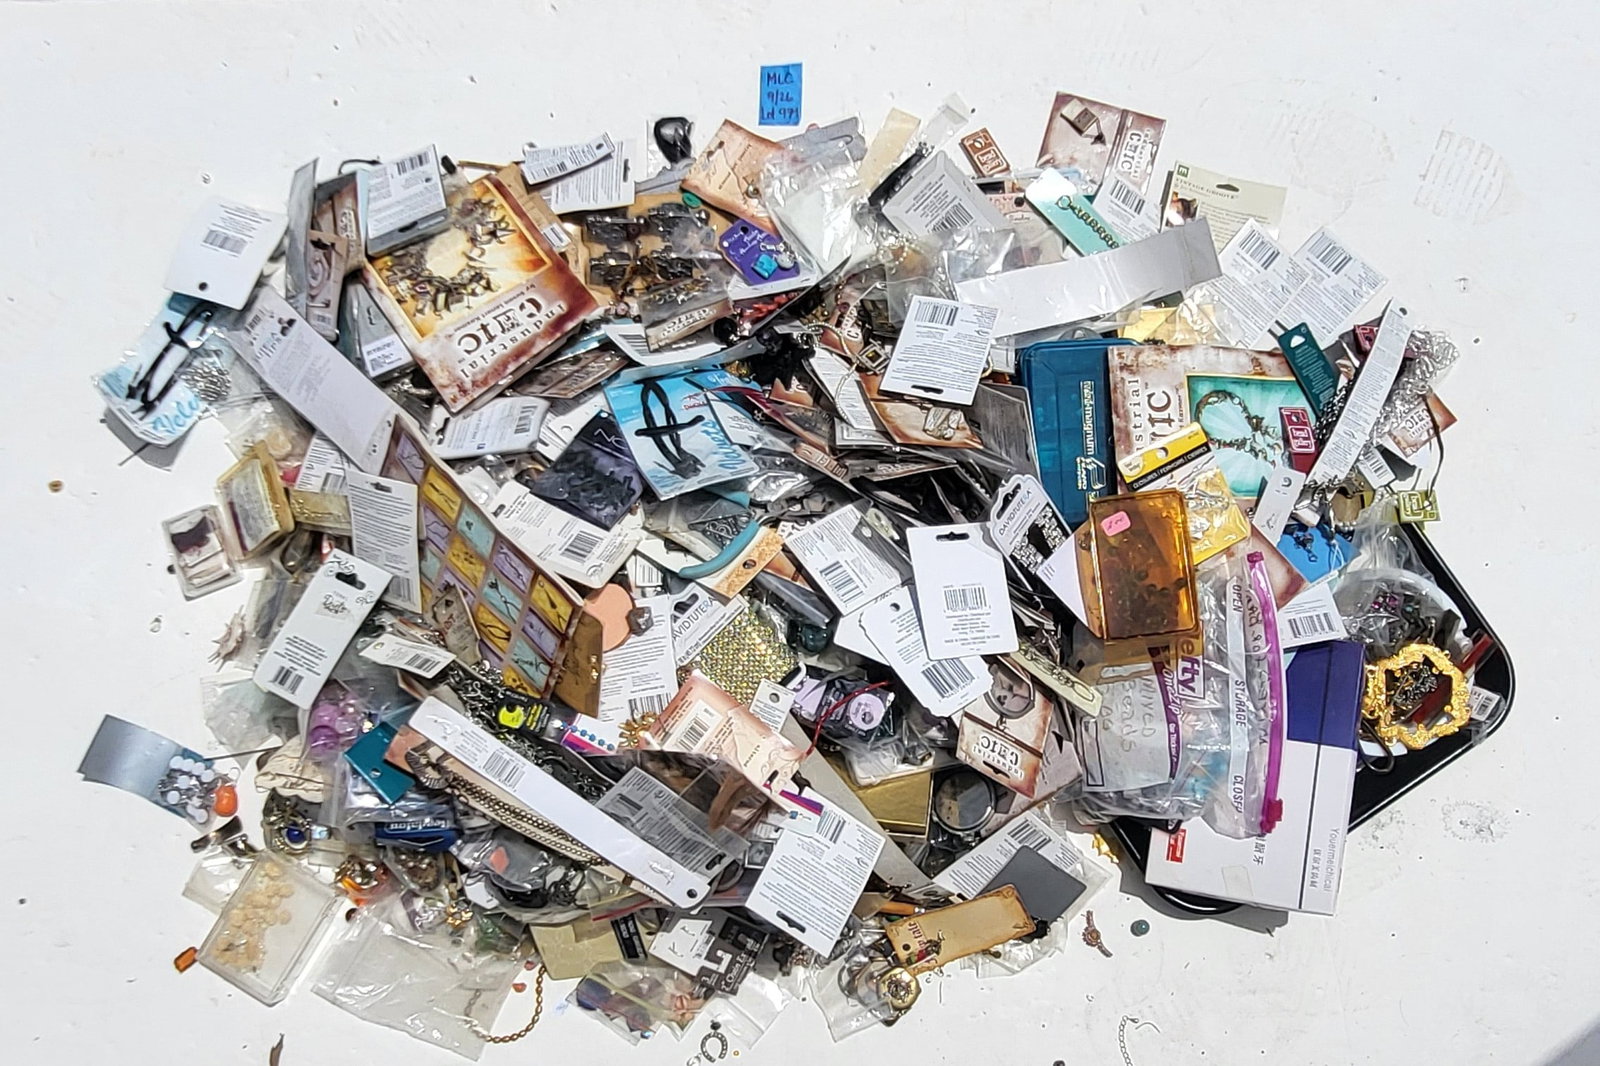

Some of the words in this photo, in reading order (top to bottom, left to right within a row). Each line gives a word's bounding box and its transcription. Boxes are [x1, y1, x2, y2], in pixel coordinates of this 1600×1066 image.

[766, 71, 794, 87] MLC
[767, 89, 794, 106] 9/26
[457, 297, 543, 355] CHIC
[460, 303, 566, 379] industrial
[671, 597, 714, 641] AVIDTUTERA
[1231, 583, 1244, 613] OPEN
[1179, 640, 1200, 694] efty
[1234, 680, 1247, 728] STORAGE
[980, 735, 1019, 766] CHIC
